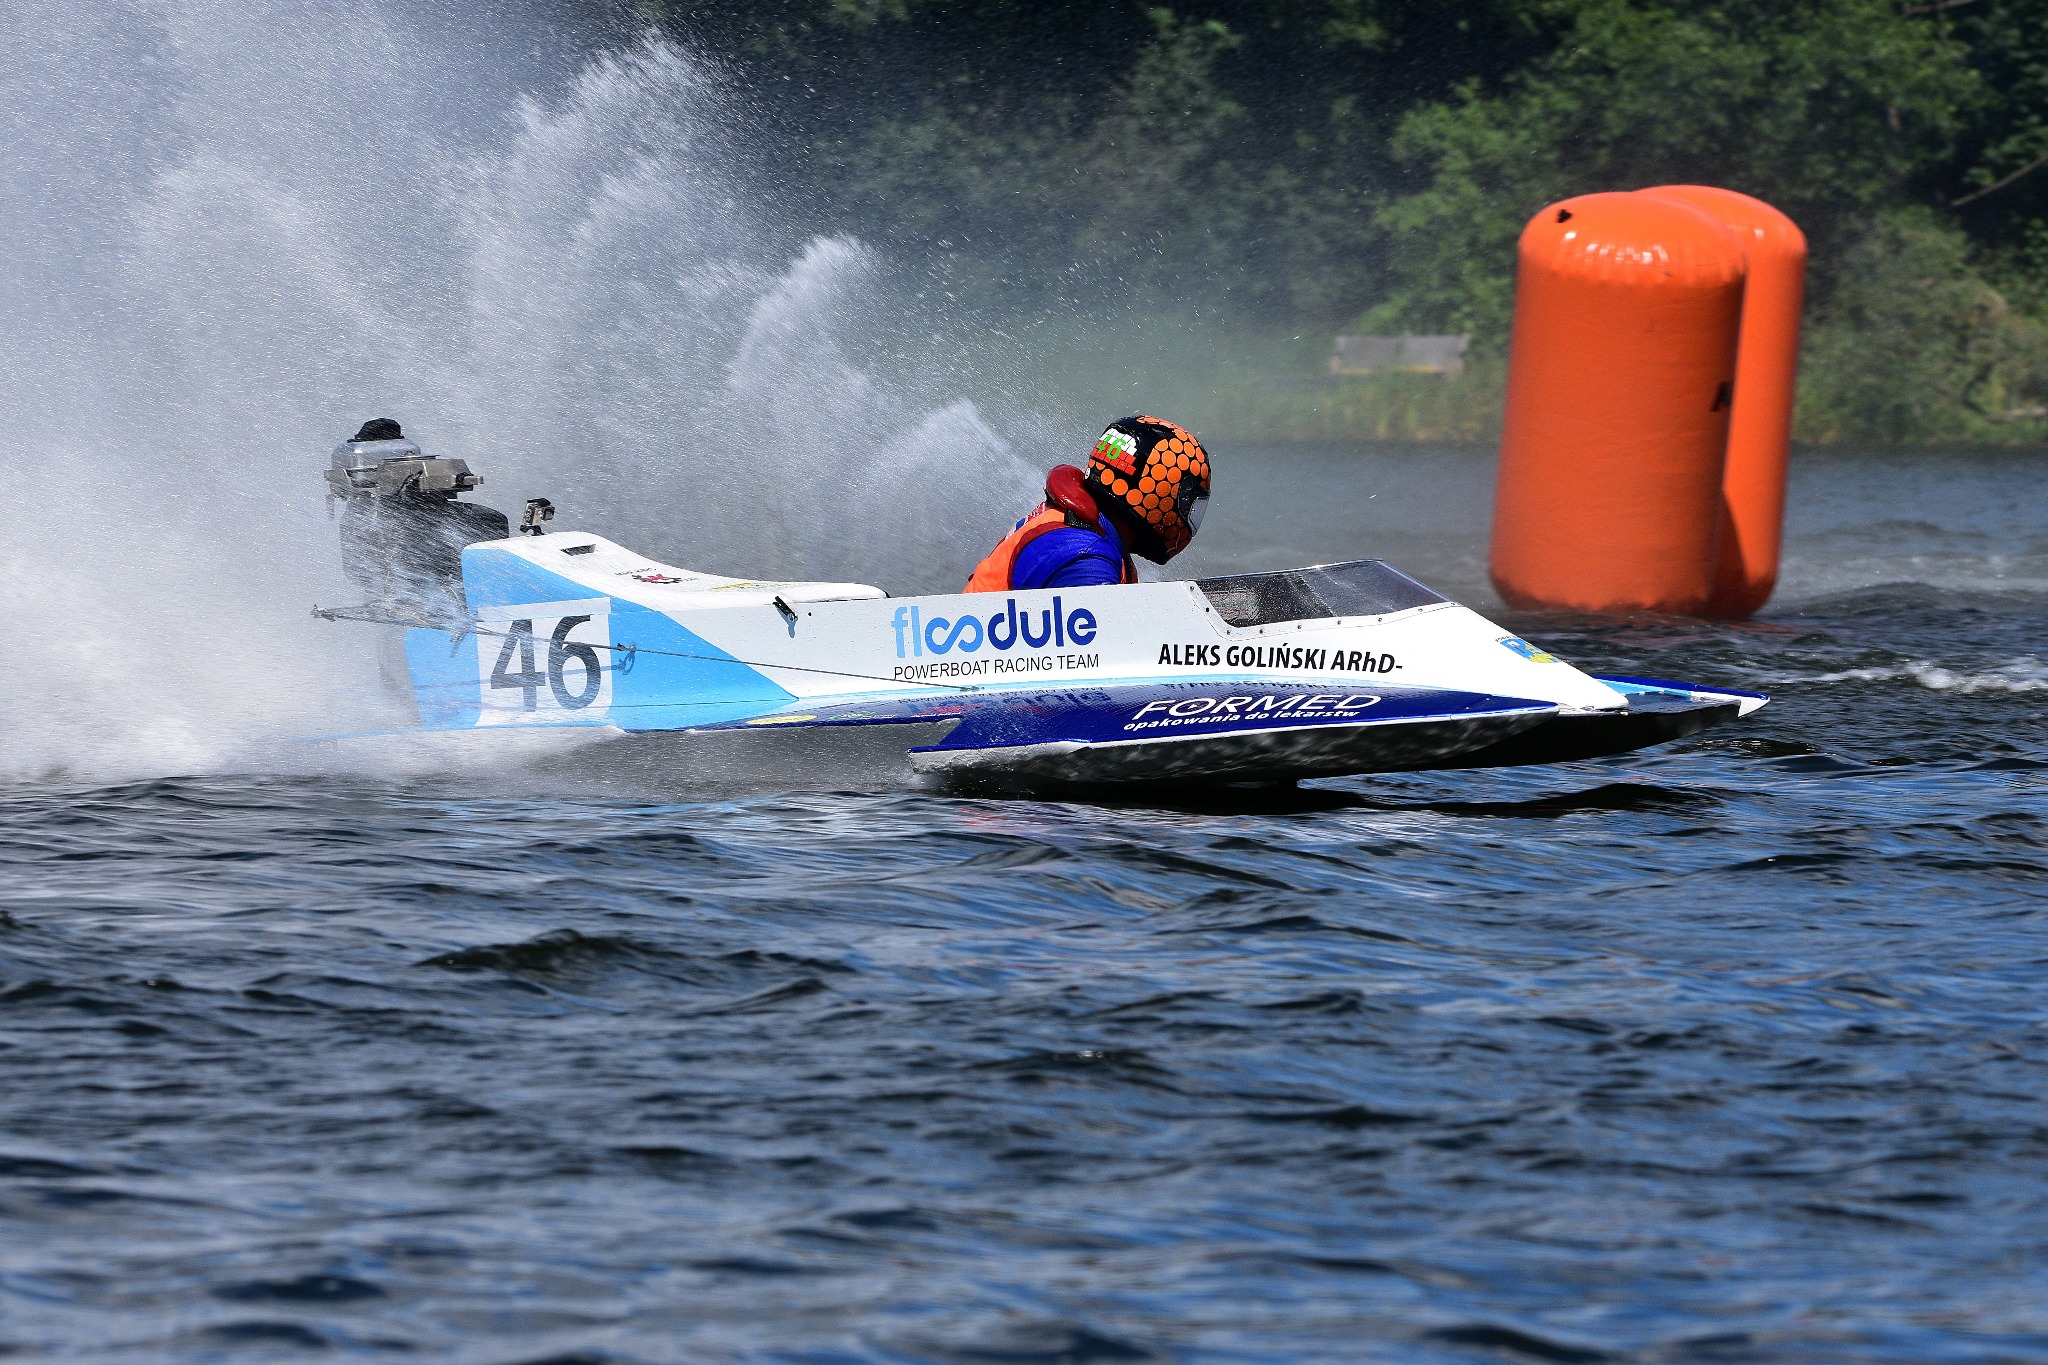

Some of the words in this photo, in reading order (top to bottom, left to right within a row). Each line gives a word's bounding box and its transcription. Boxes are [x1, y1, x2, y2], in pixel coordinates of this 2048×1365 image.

[1097, 434, 1127, 460] 46
[490, 614, 602, 712] 46
[894, 659, 990, 681] POWERBOAT
[994, 656, 1053, 674] RACING
[1057, 653, 1100, 670] TEAM
[1158, 643, 1221, 667] ALEKS
[1226, 642, 1327, 670] GOLIŃSKI
[1123, 713, 1241, 732] opakowania
[1244, 711, 1270, 720] do
[1272, 710, 1361, 719] lekarstw
[1132, 694, 1382, 721] FORMED
